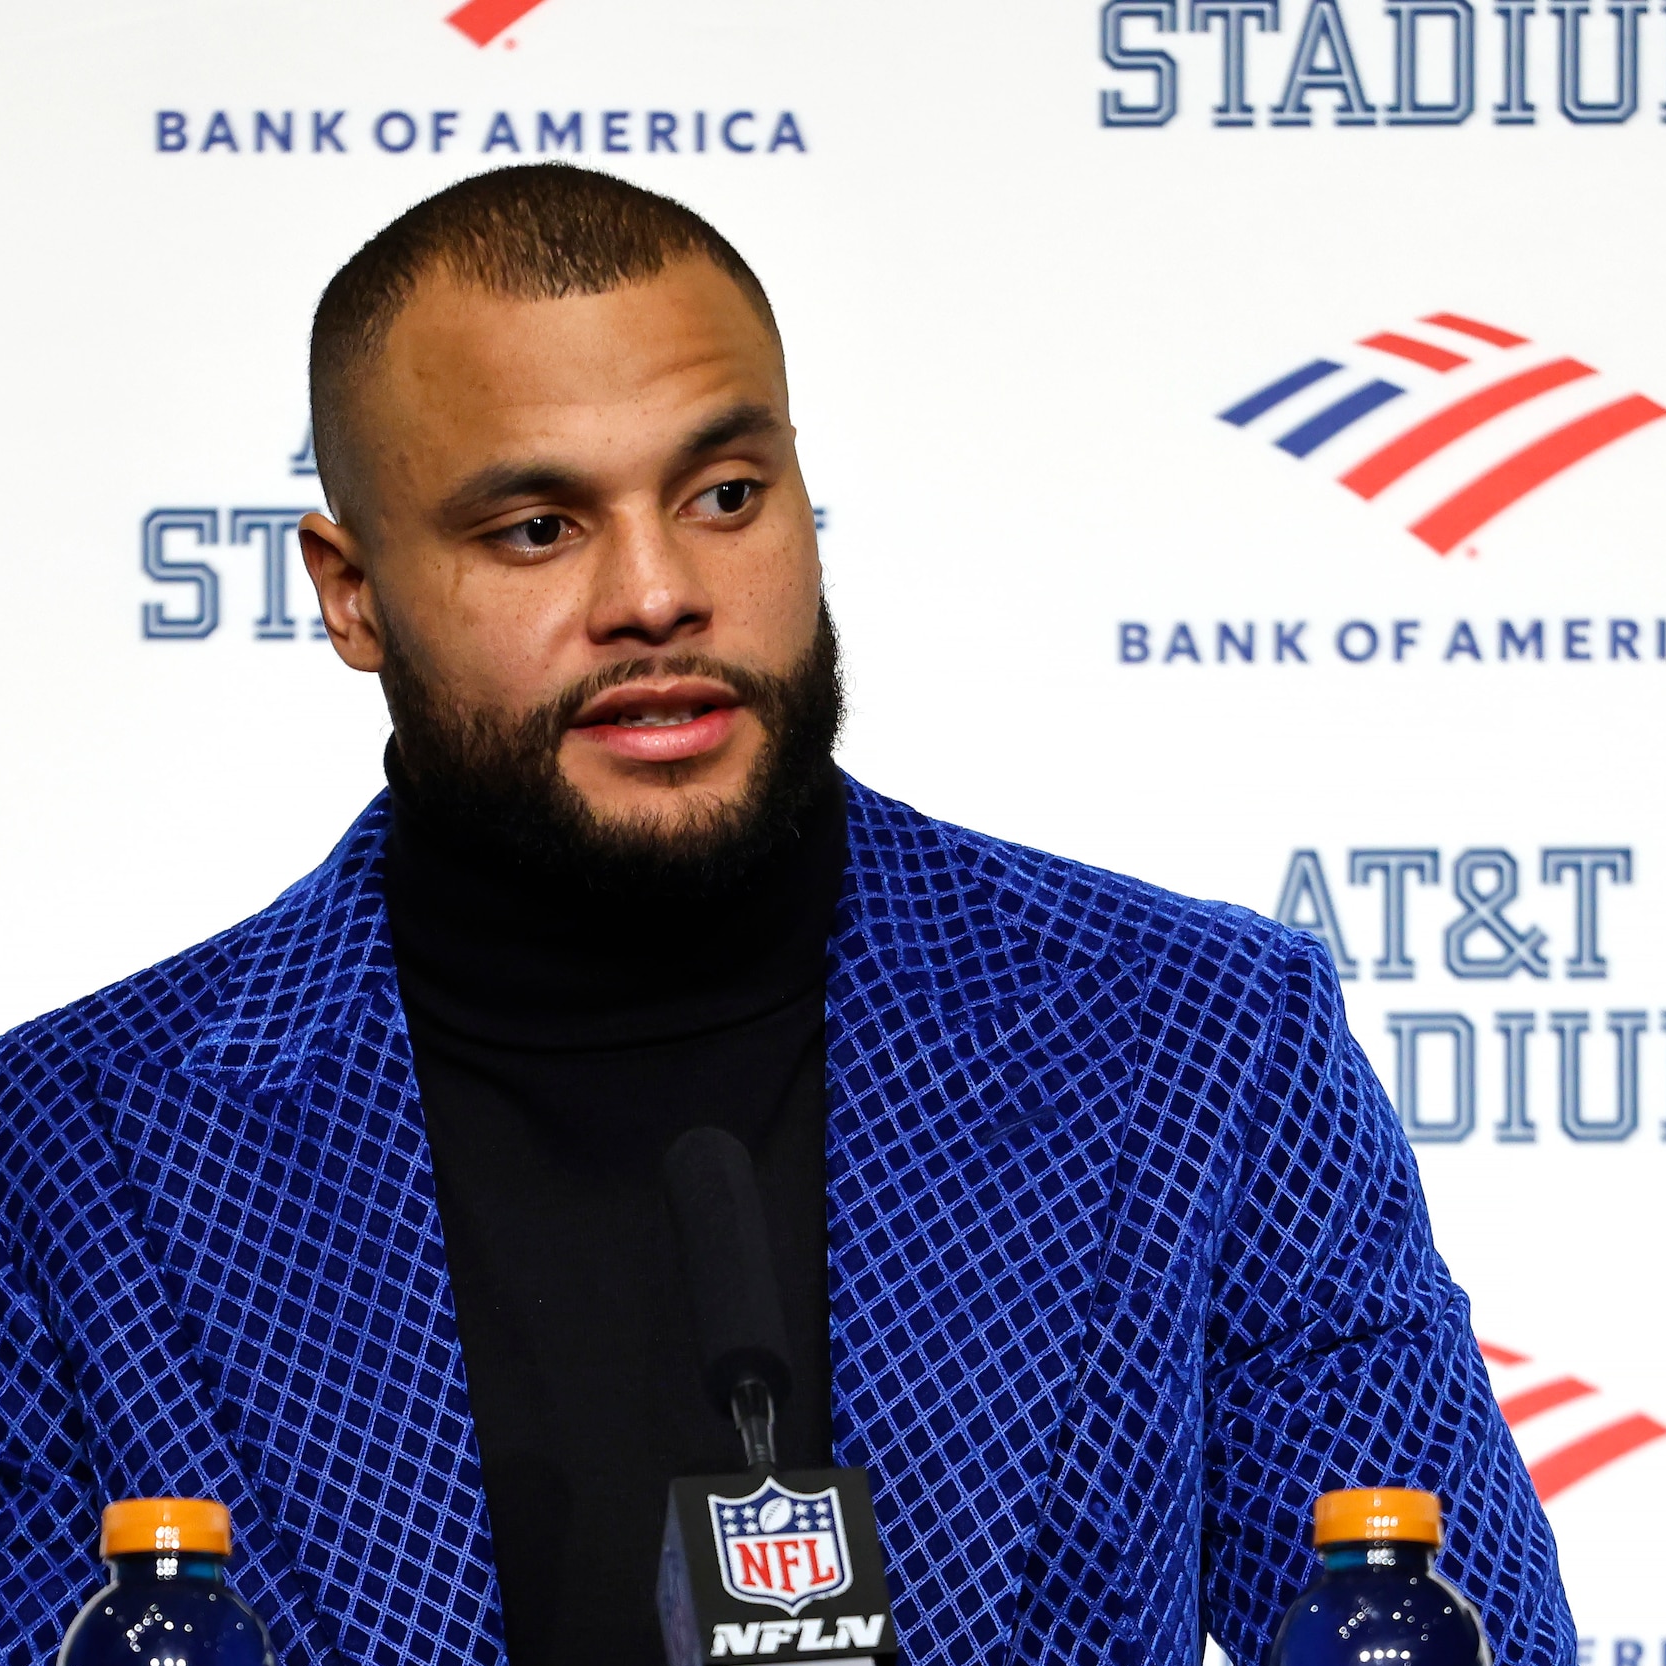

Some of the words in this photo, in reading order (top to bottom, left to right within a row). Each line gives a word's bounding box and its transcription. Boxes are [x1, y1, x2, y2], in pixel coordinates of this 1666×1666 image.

[156, 111, 346, 152] BANK
[374, 110, 458, 153] OF
[483, 111, 806, 153] AMERICA
[1120, 622, 1307, 663] BANK
[1336, 620, 1420, 663] OF
[1274, 847, 1633, 980] AT&T
[735, 1539, 835, 1594] NFL
[710, 1613, 886, 1657] NFLN
